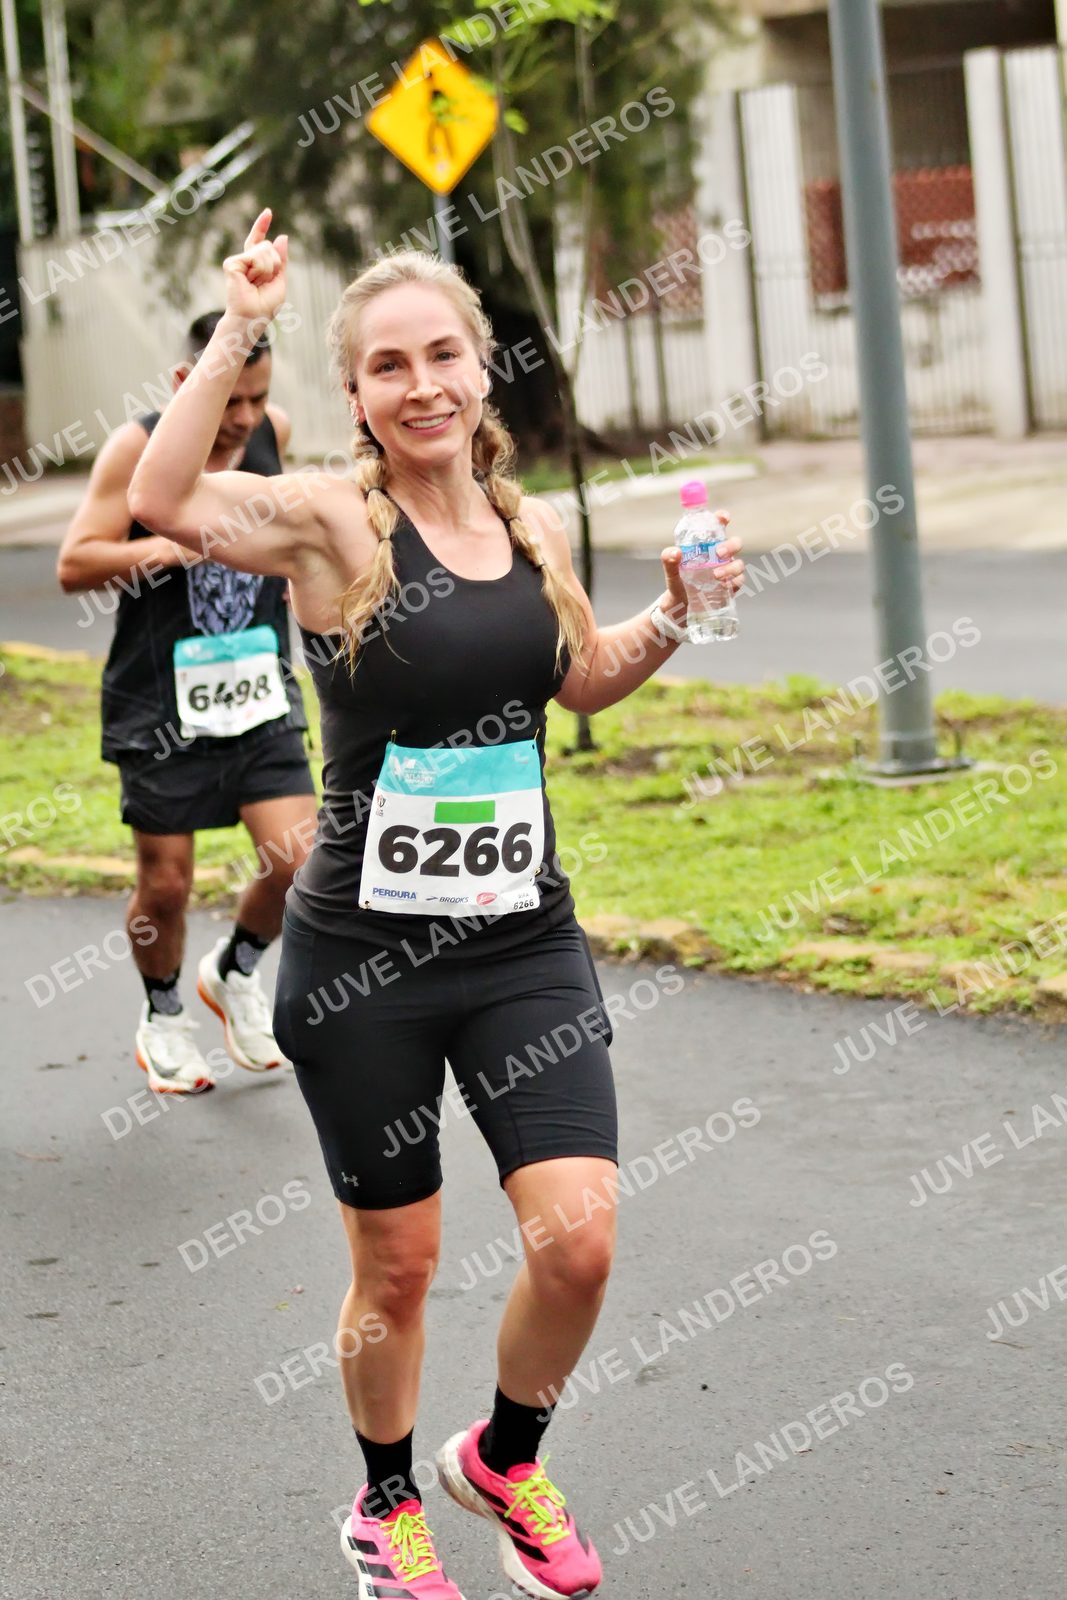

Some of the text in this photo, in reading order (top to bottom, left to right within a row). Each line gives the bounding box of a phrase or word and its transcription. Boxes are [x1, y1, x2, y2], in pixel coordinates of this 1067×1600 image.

[188, 675, 272, 712] 6498
[378, 822, 533, 877] 6266
[372, 887, 417, 900] PERDURA
[439, 896, 469, 904] BROOKS
[513, 899, 534, 910] 6266
